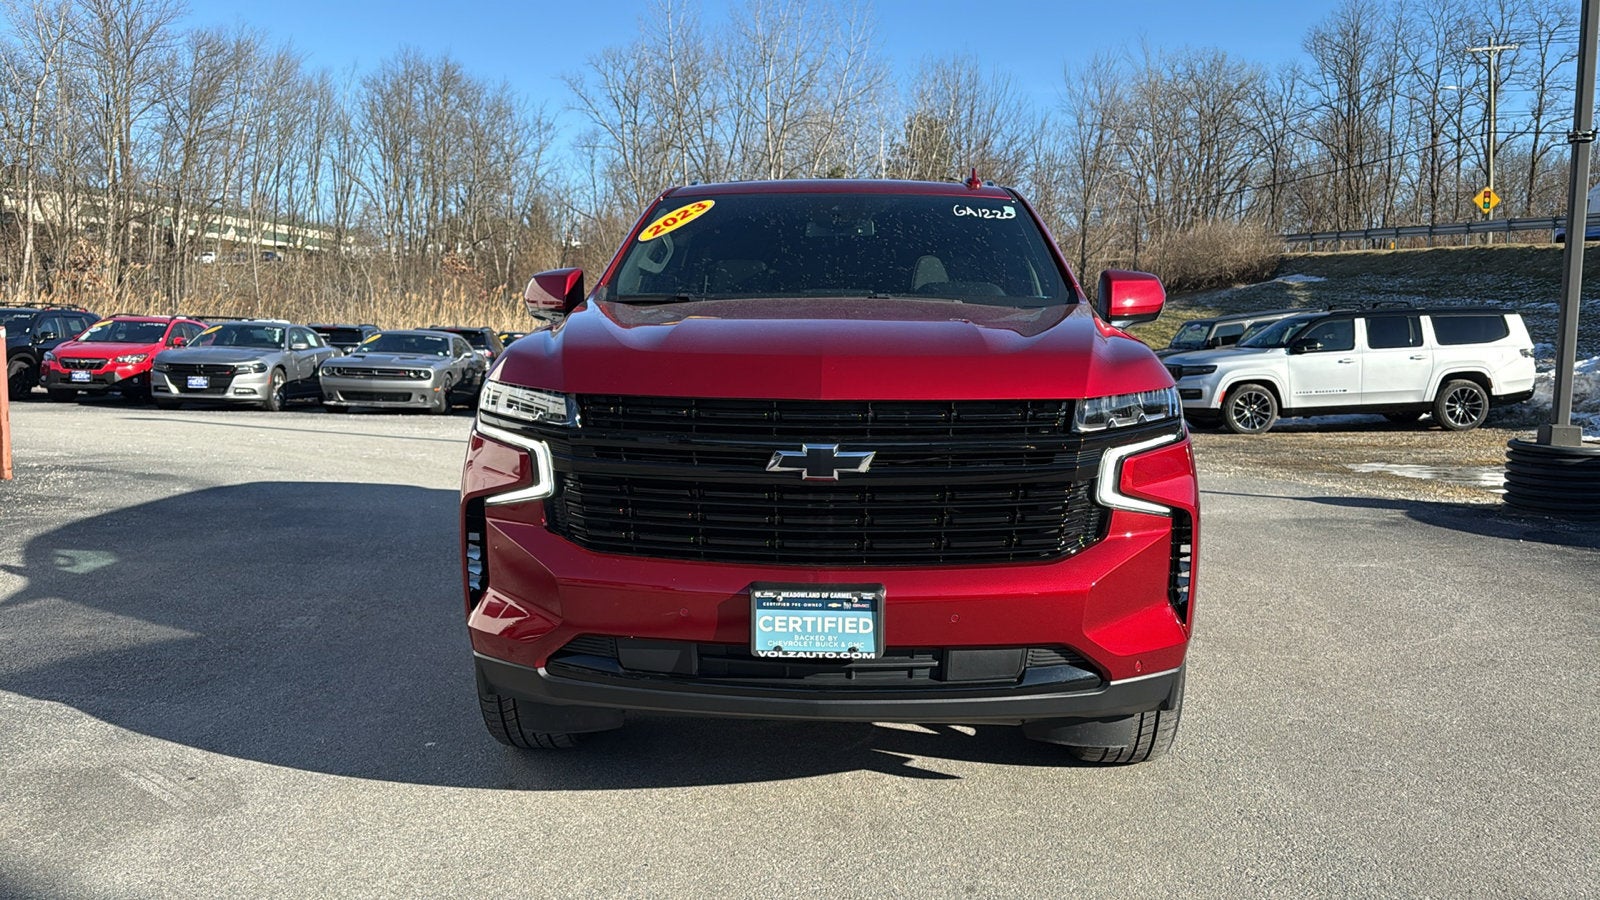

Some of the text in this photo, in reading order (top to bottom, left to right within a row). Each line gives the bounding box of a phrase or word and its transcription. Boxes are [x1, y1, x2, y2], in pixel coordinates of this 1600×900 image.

[648, 203, 708, 237] 2023
[758, 615, 874, 634] CERTIFIED
[815, 640, 839, 648] BUICK
[847, 641, 865, 649] GMC
[757, 650, 876, 660] VOLZAUTO.COM
